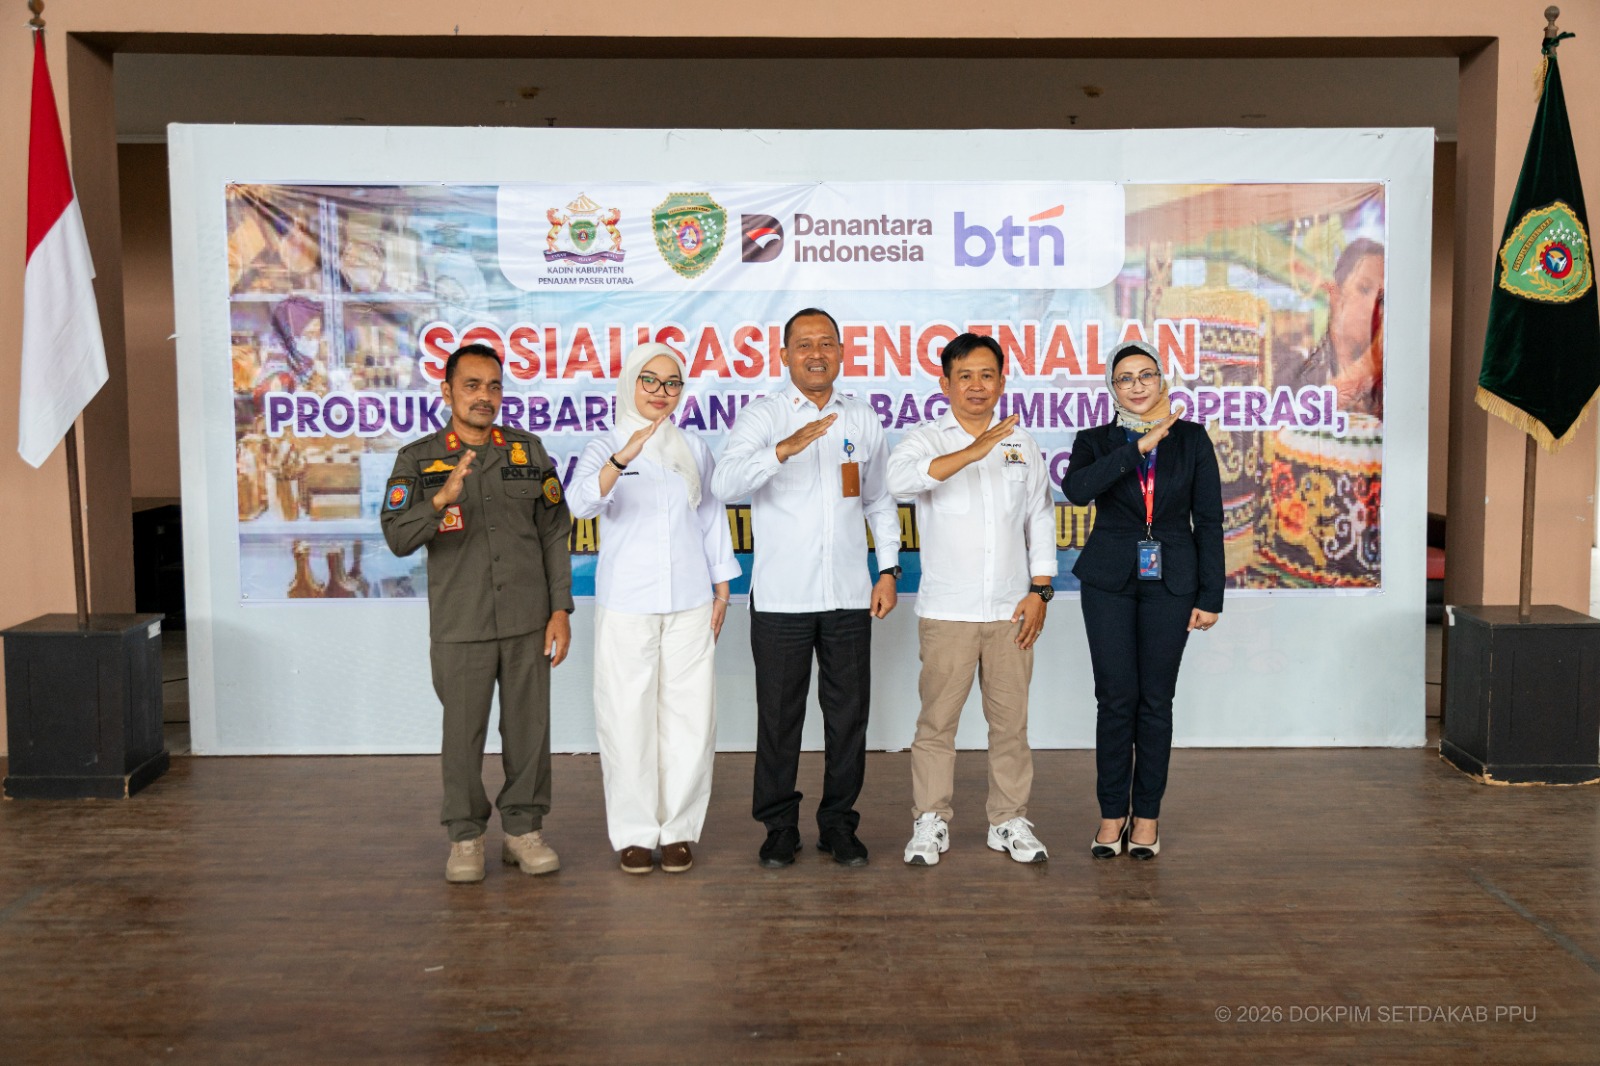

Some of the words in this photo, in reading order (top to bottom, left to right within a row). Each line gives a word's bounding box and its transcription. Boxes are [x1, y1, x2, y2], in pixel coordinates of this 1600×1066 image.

[794, 213, 932, 236] Danantara
[953, 204, 1065, 267] btn
[794, 239, 924, 263] Indonesia
[538, 277, 577, 285] PENAJAM
[579, 277, 605, 285] PASER
[606, 277, 634, 285] UTARA
[547, 266, 574, 274] KADIN
[575, 266, 624, 274] KABUPATEN
[269, 396, 445, 432] PRODUK
